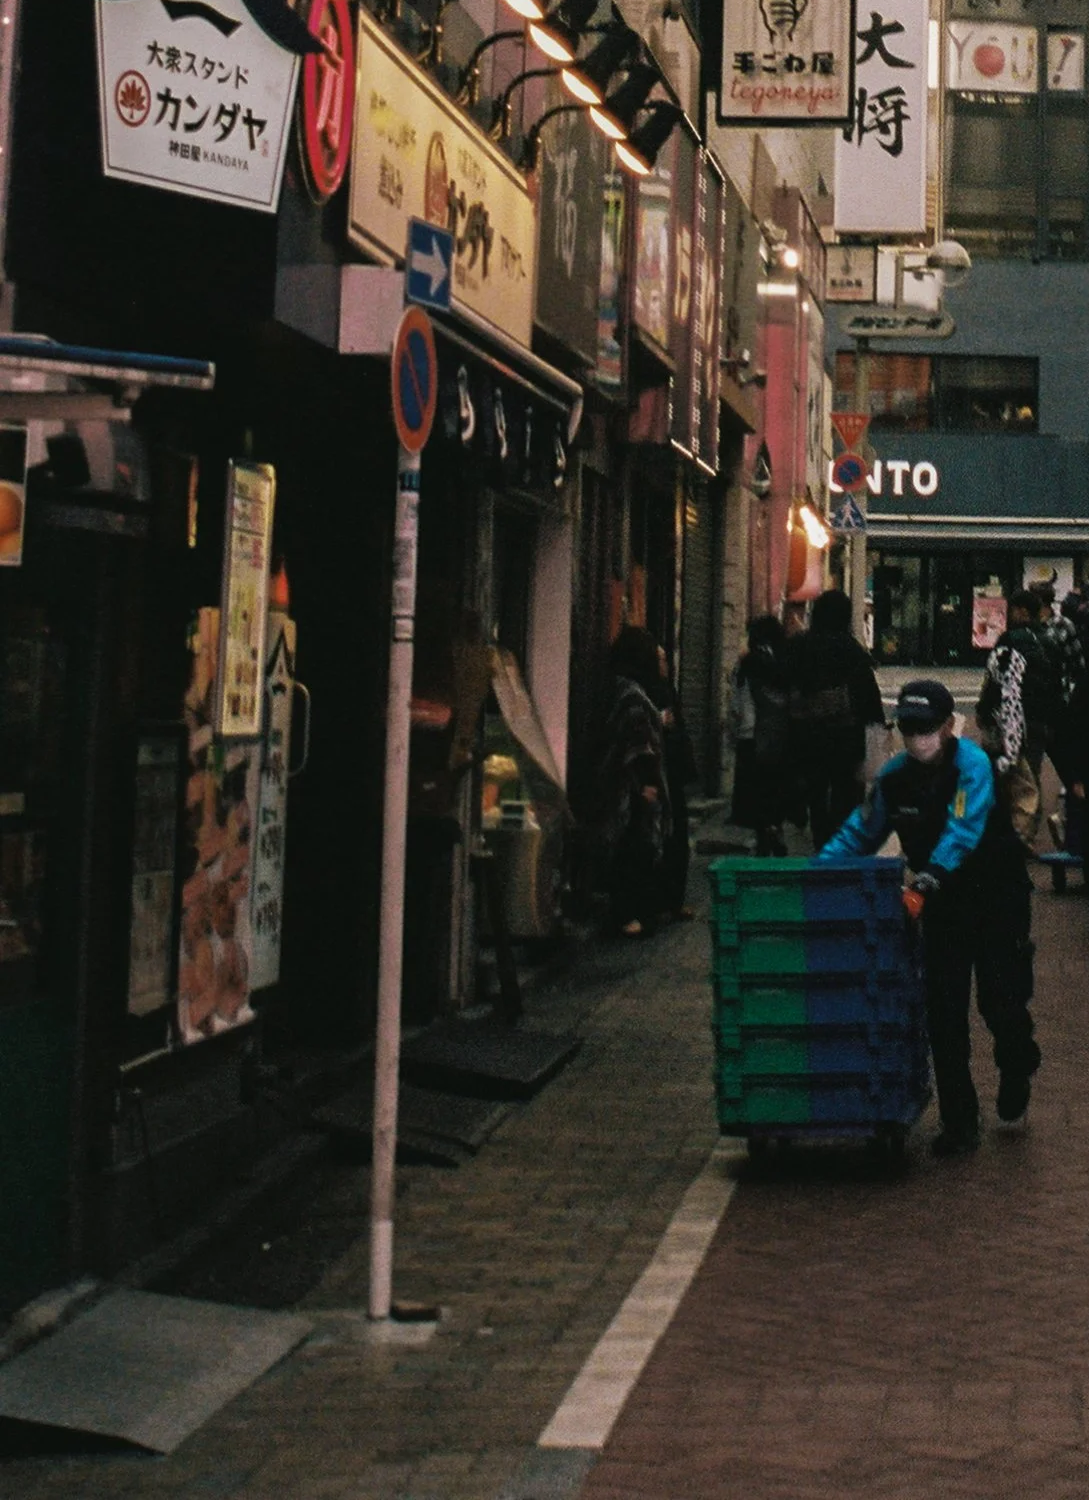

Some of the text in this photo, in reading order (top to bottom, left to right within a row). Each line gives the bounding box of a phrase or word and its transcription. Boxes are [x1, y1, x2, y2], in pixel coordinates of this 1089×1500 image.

[147, 41, 249, 89] 大衆スタンド
[843, 11, 915, 157] 大将
[154, 87, 267, 151] カンダヤ
[203, 151, 249, 172] KANDAYA
